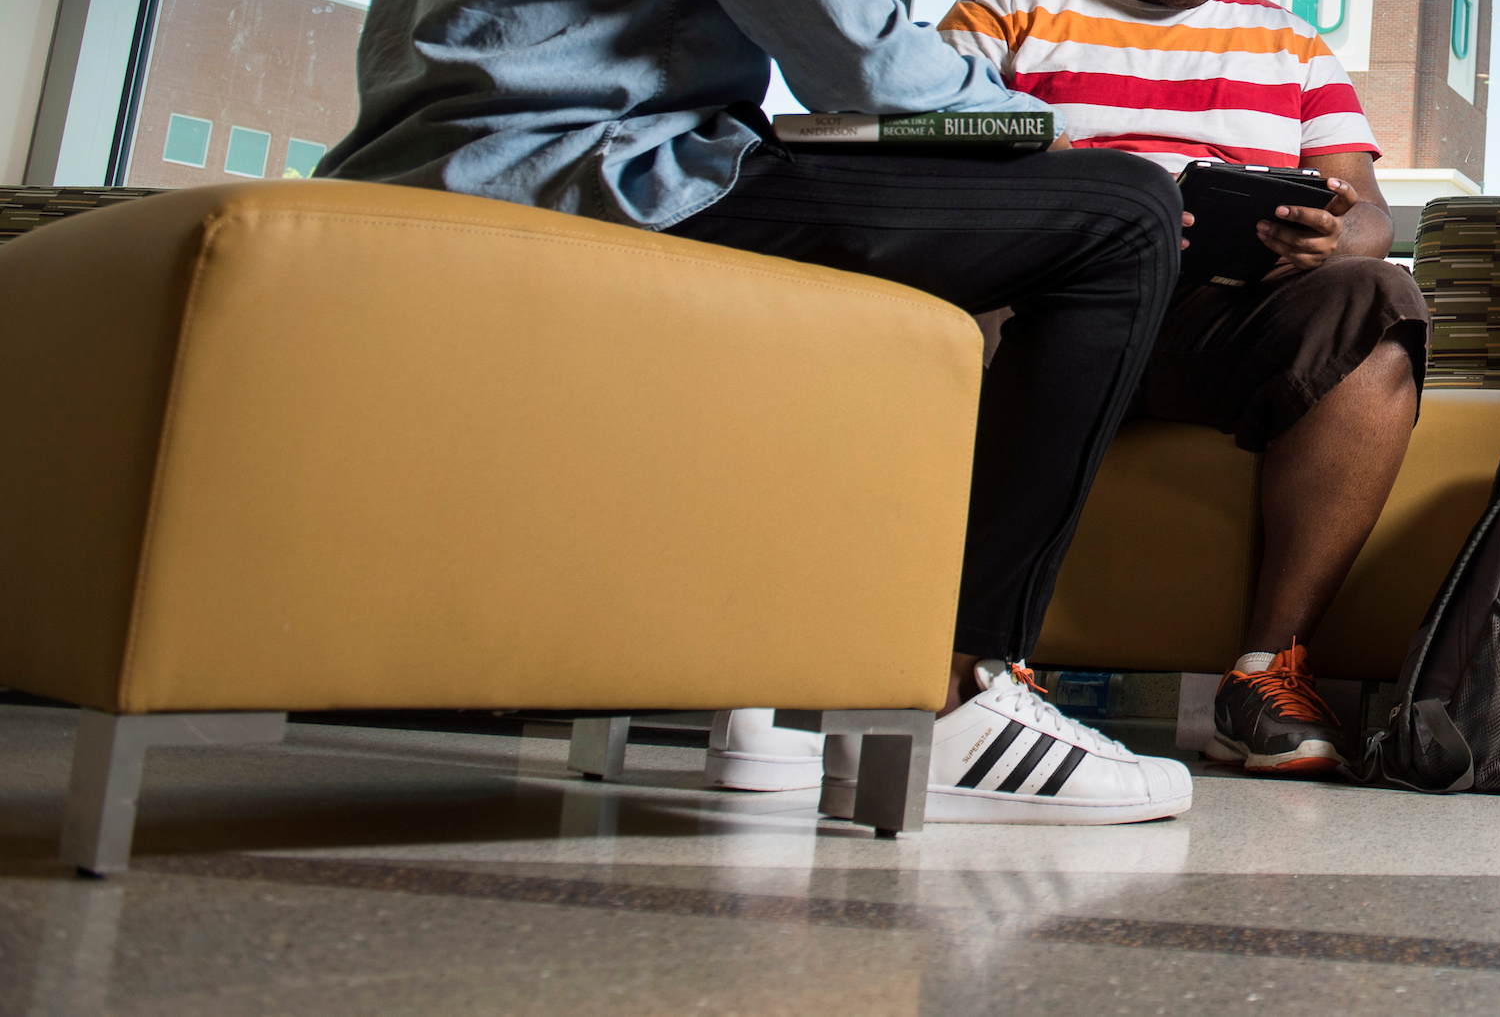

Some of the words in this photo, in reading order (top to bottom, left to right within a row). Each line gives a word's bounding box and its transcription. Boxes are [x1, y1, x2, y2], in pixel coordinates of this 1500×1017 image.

[814, 117, 843, 126] SCOT
[910, 118, 927, 126] LIKE
[928, 118, 936, 126] A
[800, 127, 858, 137] ANDERSON
[883, 126, 925, 136] BECOME
[927, 126, 936, 136] A
[944, 118, 1045, 136] BILLIONAIRE
[962, 727, 993, 764] SUPERSTAR
